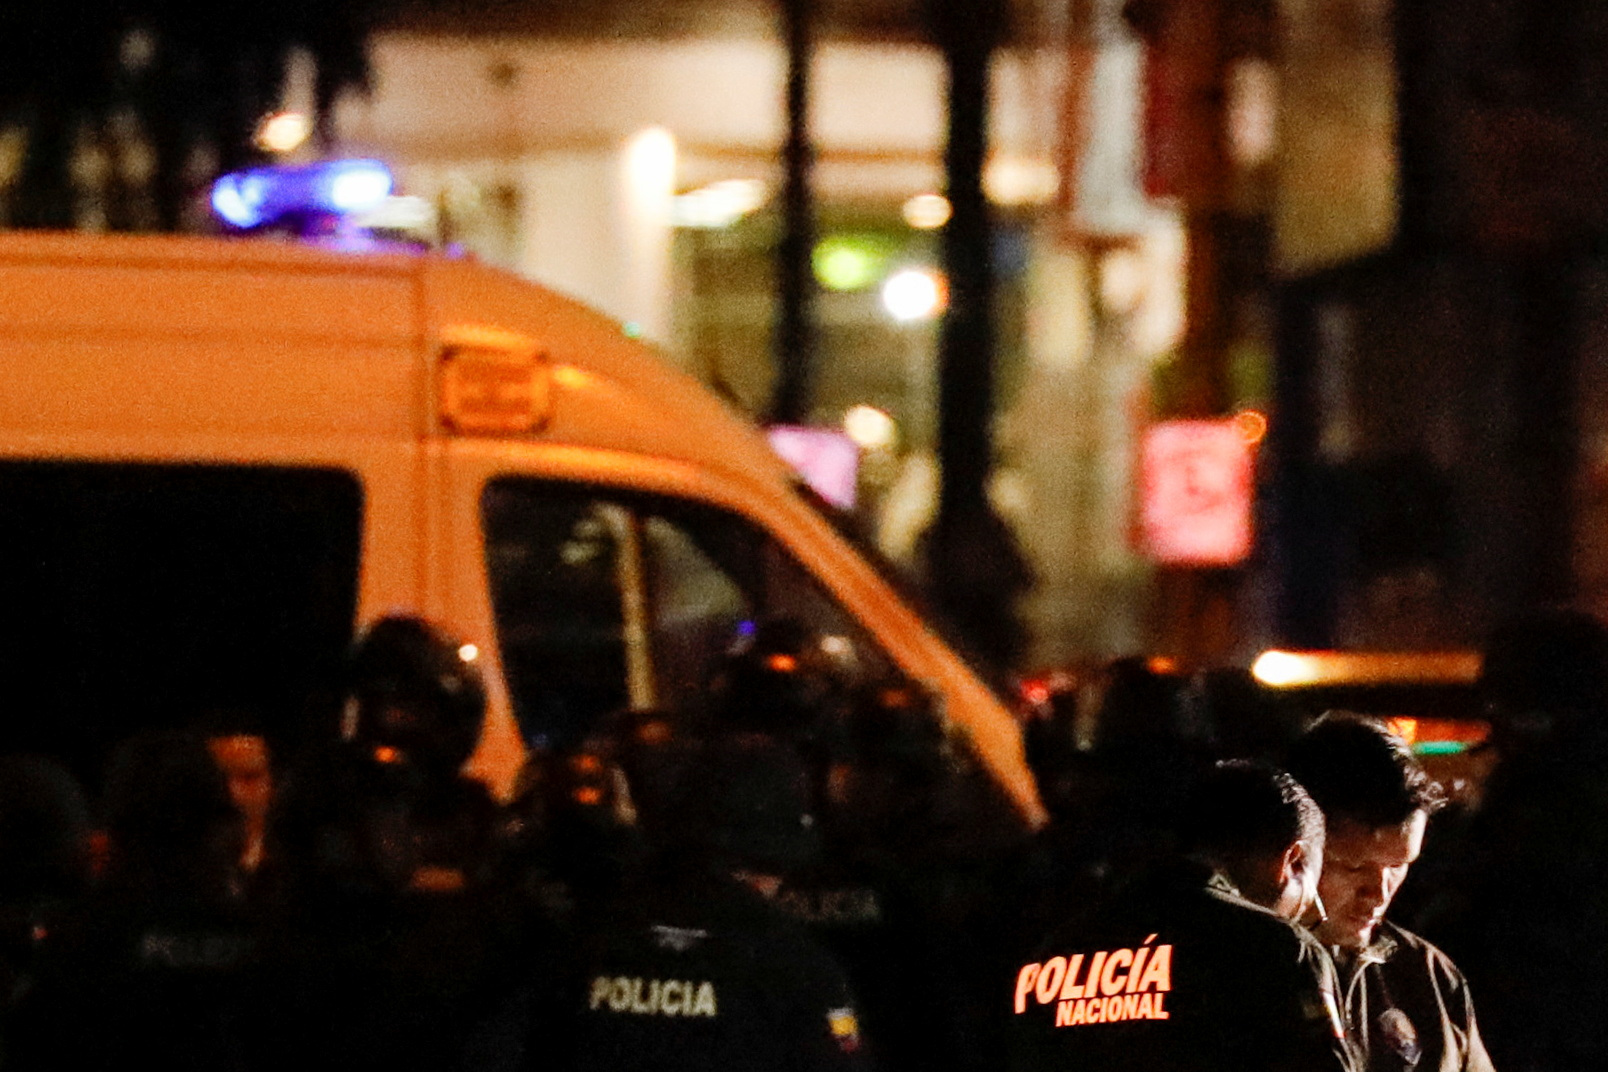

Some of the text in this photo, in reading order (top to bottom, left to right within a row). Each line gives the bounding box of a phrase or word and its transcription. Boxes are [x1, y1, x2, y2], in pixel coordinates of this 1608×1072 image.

[1014, 933, 1173, 1015] POLICÍA
[589, 976, 716, 1017] POLICIA
[1055, 993, 1170, 1028] NACIONAL
